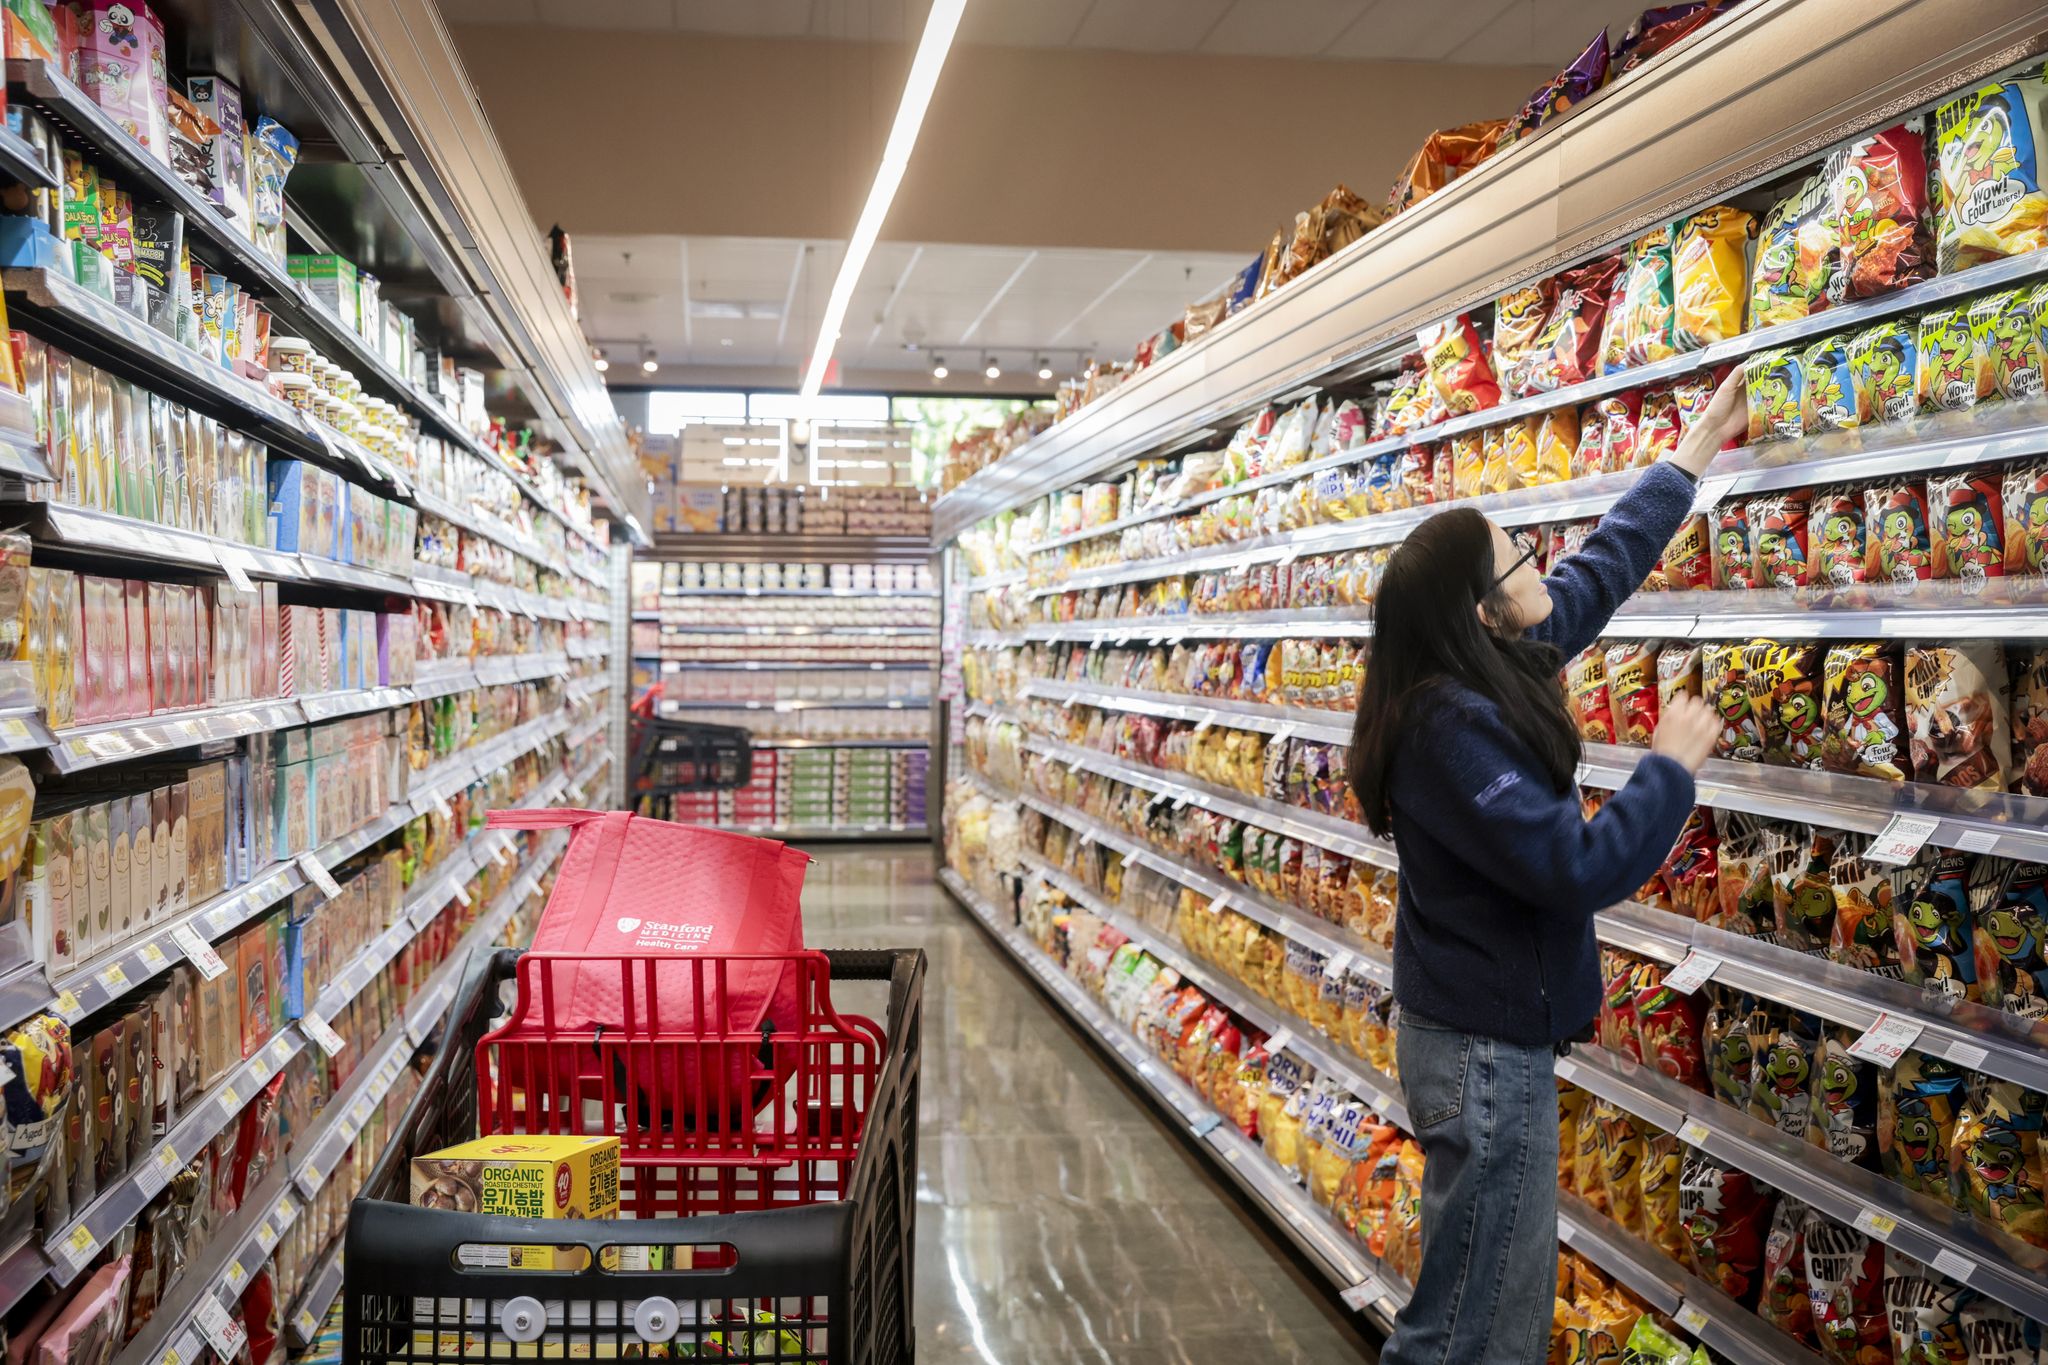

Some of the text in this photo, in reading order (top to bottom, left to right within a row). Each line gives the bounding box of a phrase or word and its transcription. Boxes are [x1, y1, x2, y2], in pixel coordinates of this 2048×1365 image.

[1973, 177, 2008, 205] Wow!
[1967, 190, 2020, 223] Four Layers!
[2012, 365, 2041, 389] Wow!
[1947, 381, 1974, 399] Wow!
[2029, 381, 2044, 391] Laye
[1885, 395, 1909, 415] Wow!
[1961, 393, 1975, 404] Laye
[1821, 402, 1837, 419] ow!
[1889, 843, 1919, 857] $3.99
[1941, 857, 1965, 868] NEWS
[2019, 865, 2048, 877] NEWS
[1892, 867, 1924, 897] IPS
[643, 920, 713, 934] Stanford
[640, 929, 711, 940] MEDICINE
[635, 939, 698, 951] Health Care
[1873, 1043, 1903, 1058] $3.29
[1271, 1052, 1302, 1080] ORN
[18, 1128, 43, 1142] Aged
[589, 1146, 618, 1168] ORGANIC
[483, 1168, 545, 1182] ORGANIC
[557, 1172, 570, 1191] 40
[512, 1181, 543, 1189] CHESTNUT
